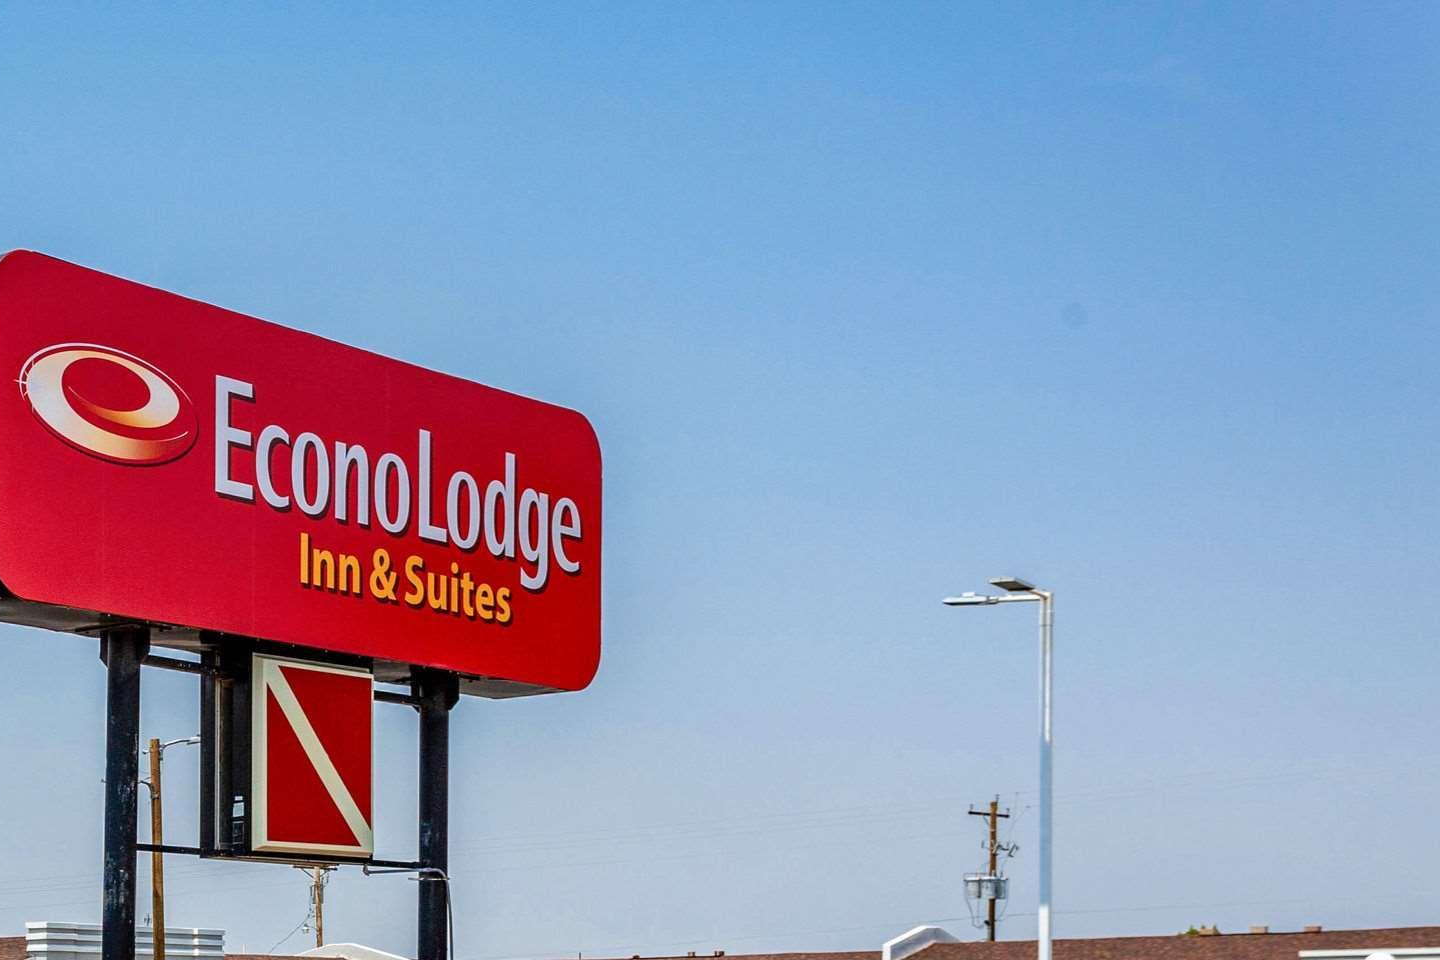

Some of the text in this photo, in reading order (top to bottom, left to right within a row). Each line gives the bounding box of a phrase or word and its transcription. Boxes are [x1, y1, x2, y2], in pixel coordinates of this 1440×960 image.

[215, 374, 581, 590] EconoLodge
[300, 532, 511, 623] Inn & Suites
